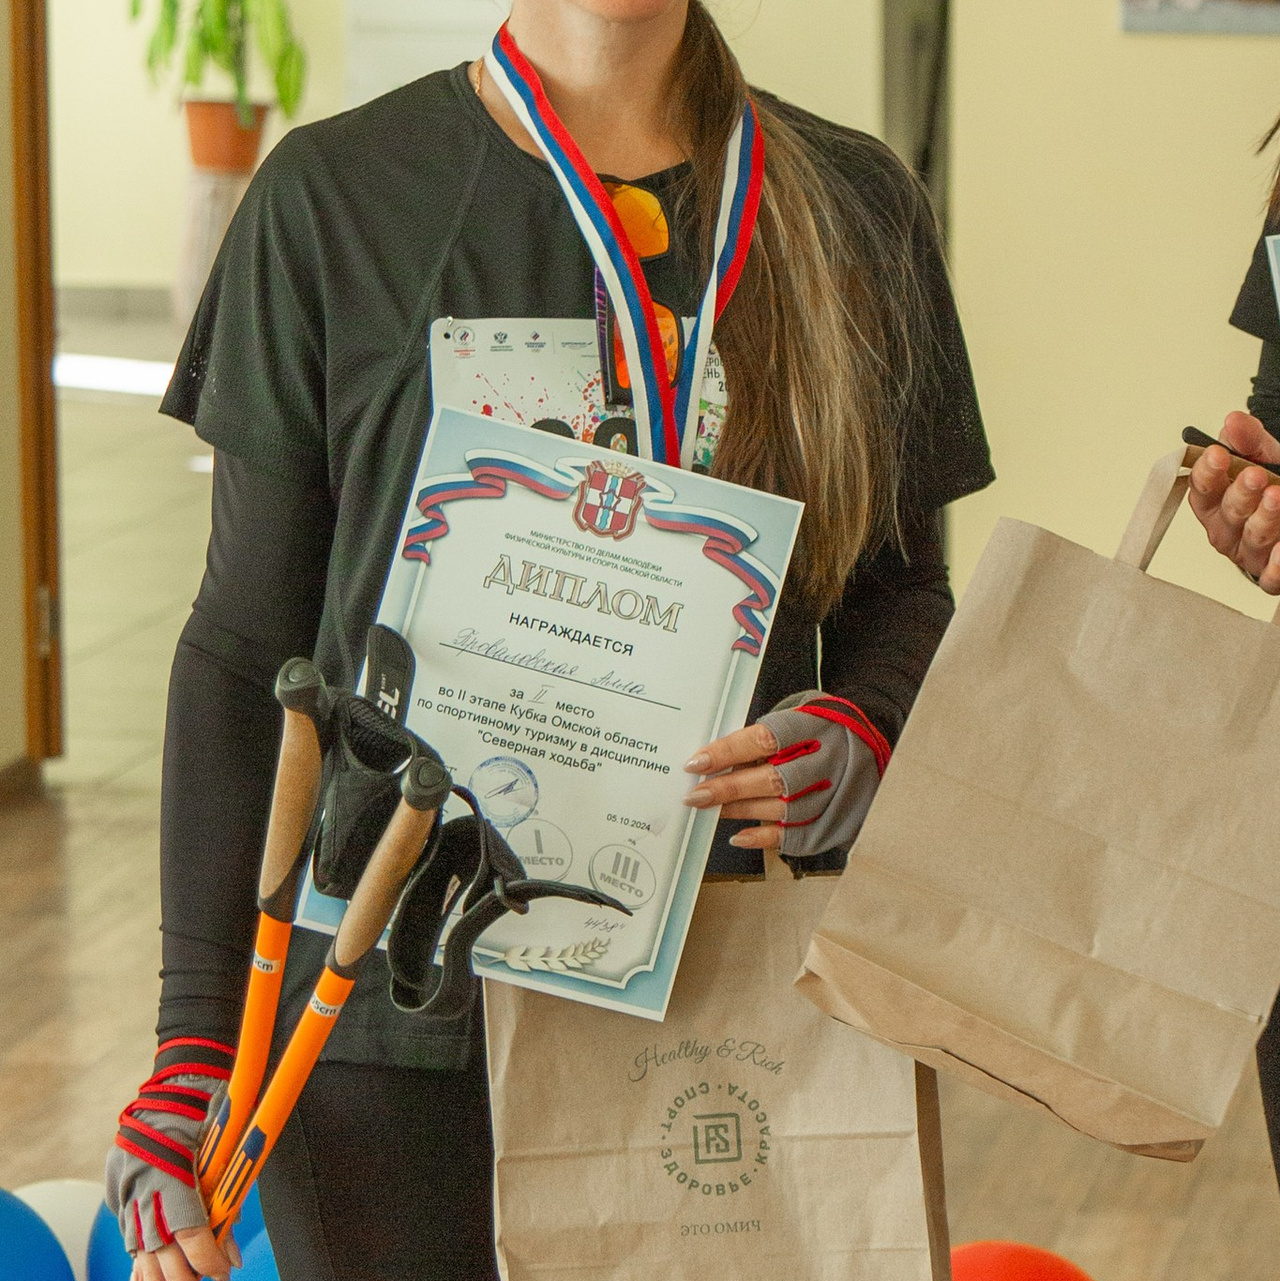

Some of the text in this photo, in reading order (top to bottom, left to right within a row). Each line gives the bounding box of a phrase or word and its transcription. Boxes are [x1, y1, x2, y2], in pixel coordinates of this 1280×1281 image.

[504, 532, 551, 551] ФИЗИЧЕСКОЙ
[551, 546, 585, 562] КУЛЬТУРЫ
[592, 556, 619, 571] СПОРТА
[620, 564, 650, 579] ОМСКОЙ
[650, 573, 683, 588] ОБЛАСТИ
[530, 530, 585, 552] МИНИСТЕРСТВО
[585, 545, 596, 555] ПО
[598, 548, 621, 562] ДЕЛАМ
[483, 553, 685, 633] ДИПЛОМ
[509, 612, 634, 656] НАГРАЖДАЕТСЯ
[438, 686, 454, 698] во
[469, 694, 507, 713] этапе
[510, 704, 548, 724] Кубка
[551, 715, 601, 739] Омской
[604, 731, 658, 754] области
[509, 688, 524, 700] за
[556, 701, 595, 719] место
[417, 697, 671, 775] по спортивному туризму в дисциплине
[478, 729, 603, 773] "Северная ходьба"
[606, 813, 651, 831] 05.10.2024
[519, 856, 565, 867] МЕСТО
[612, 851, 641, 884] III
[600, 873, 644, 898] МЕСТО
[627, 1038, 786, 1083] Healthy & Rich
[661, 1081, 710, 1133] СПОРТ
[727, 1082, 772, 1165] КРАСОТА
[660, 1147, 753, 1197] ЗДОРОВЬЕ
[680, 1223, 711, 1237] ЭТО
